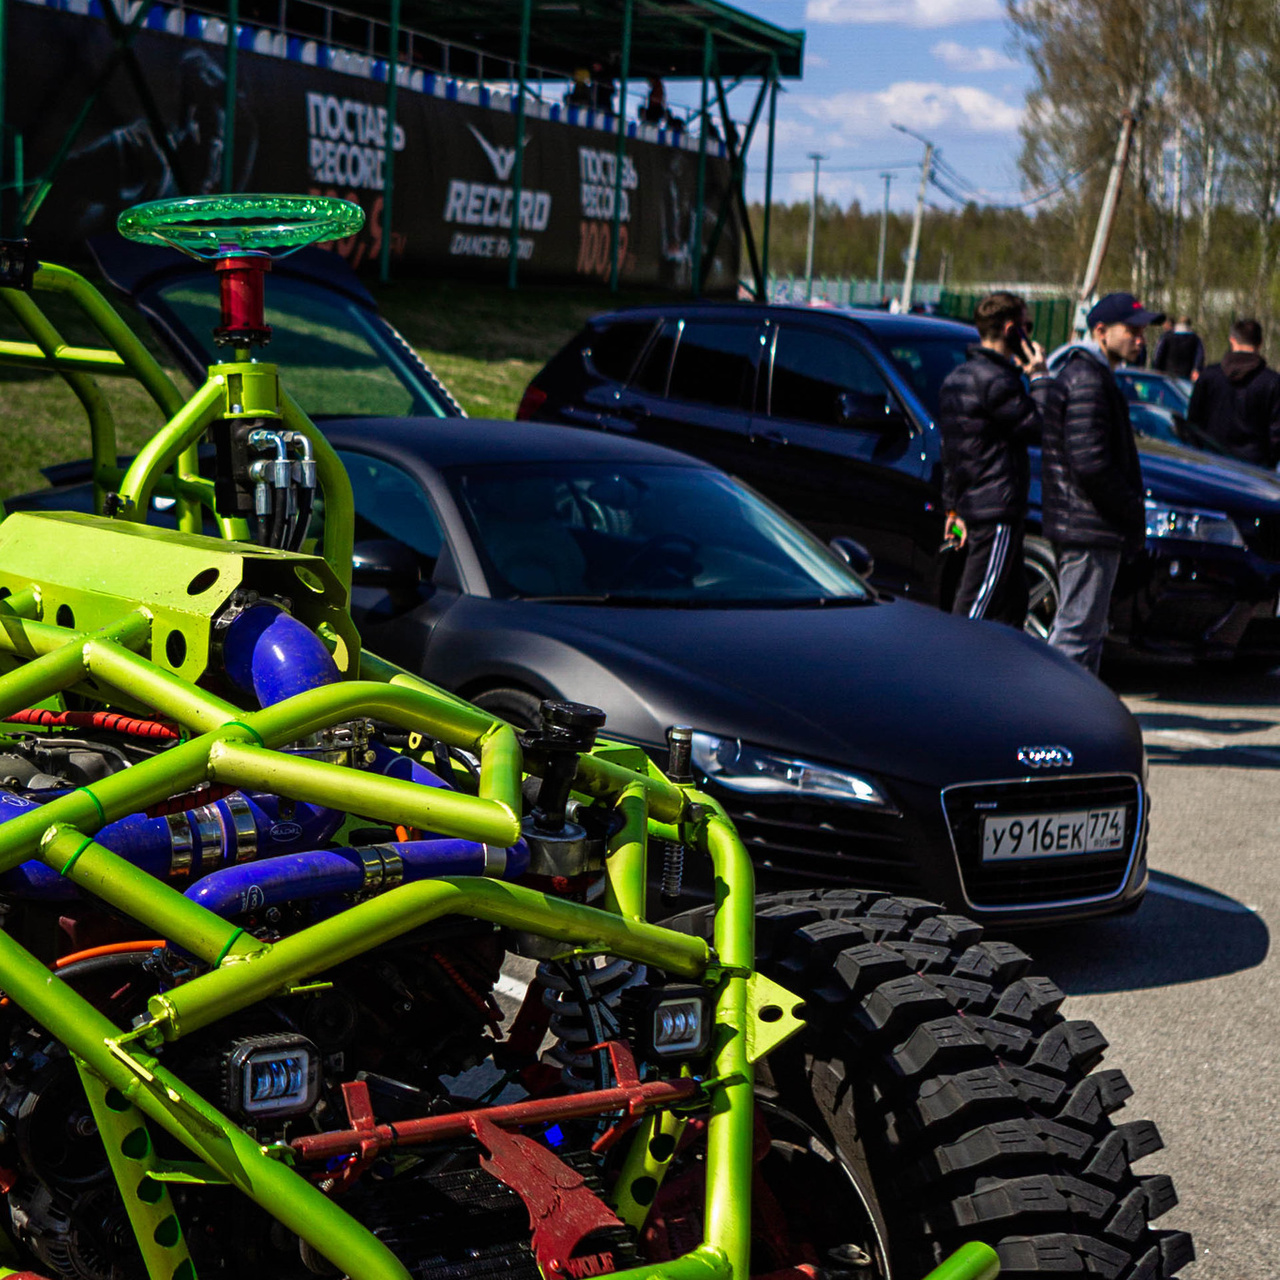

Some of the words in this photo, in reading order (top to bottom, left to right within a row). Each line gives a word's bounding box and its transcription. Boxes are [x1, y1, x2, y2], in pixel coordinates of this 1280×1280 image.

[450, 233, 495, 258] DANCE
[1089, 810, 1120, 839] 774
[565, 1251, 615, 1279] WOLF
